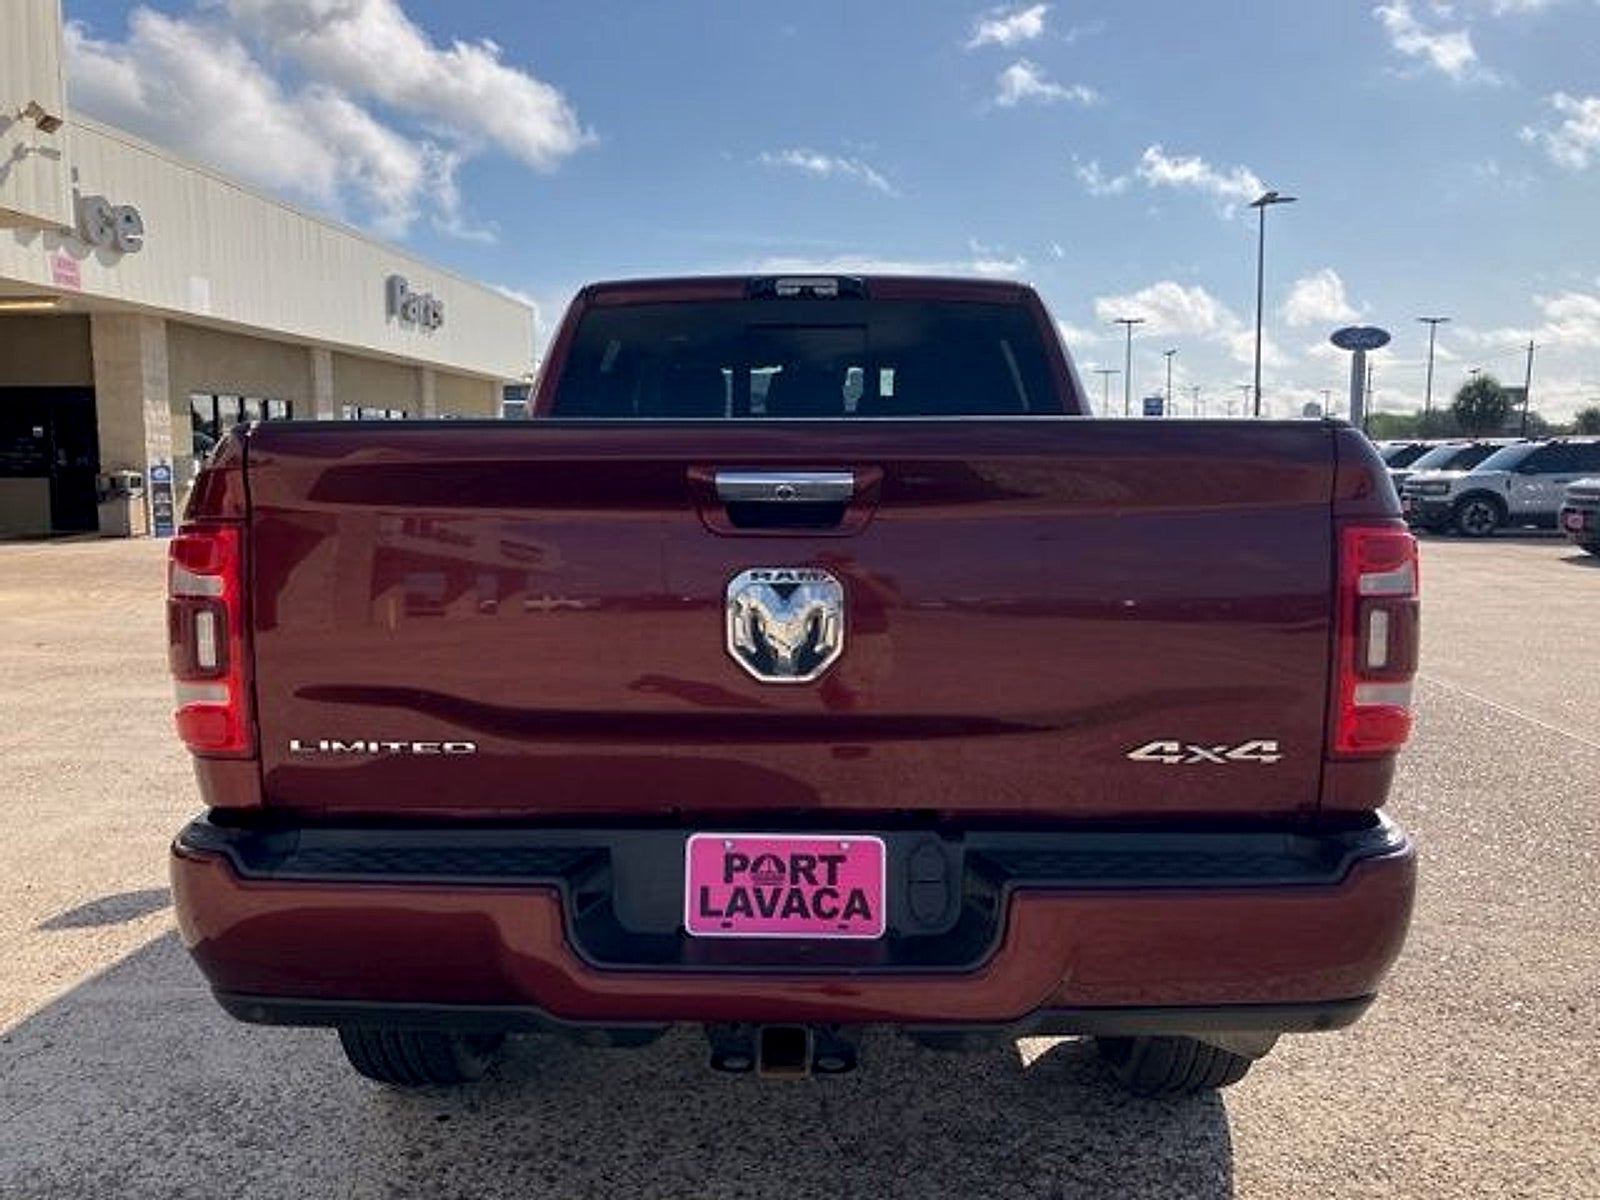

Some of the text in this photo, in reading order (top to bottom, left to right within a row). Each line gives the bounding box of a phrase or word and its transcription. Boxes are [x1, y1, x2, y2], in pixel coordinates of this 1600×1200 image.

[385, 275, 443, 329] Parts
[749, 571, 819, 582] RAM
[289, 739, 477, 754] LIMITED
[1127, 740, 1282, 764] 4x4
[724, 853, 847, 885] PORT
[699, 886, 872, 920] LAVACA
